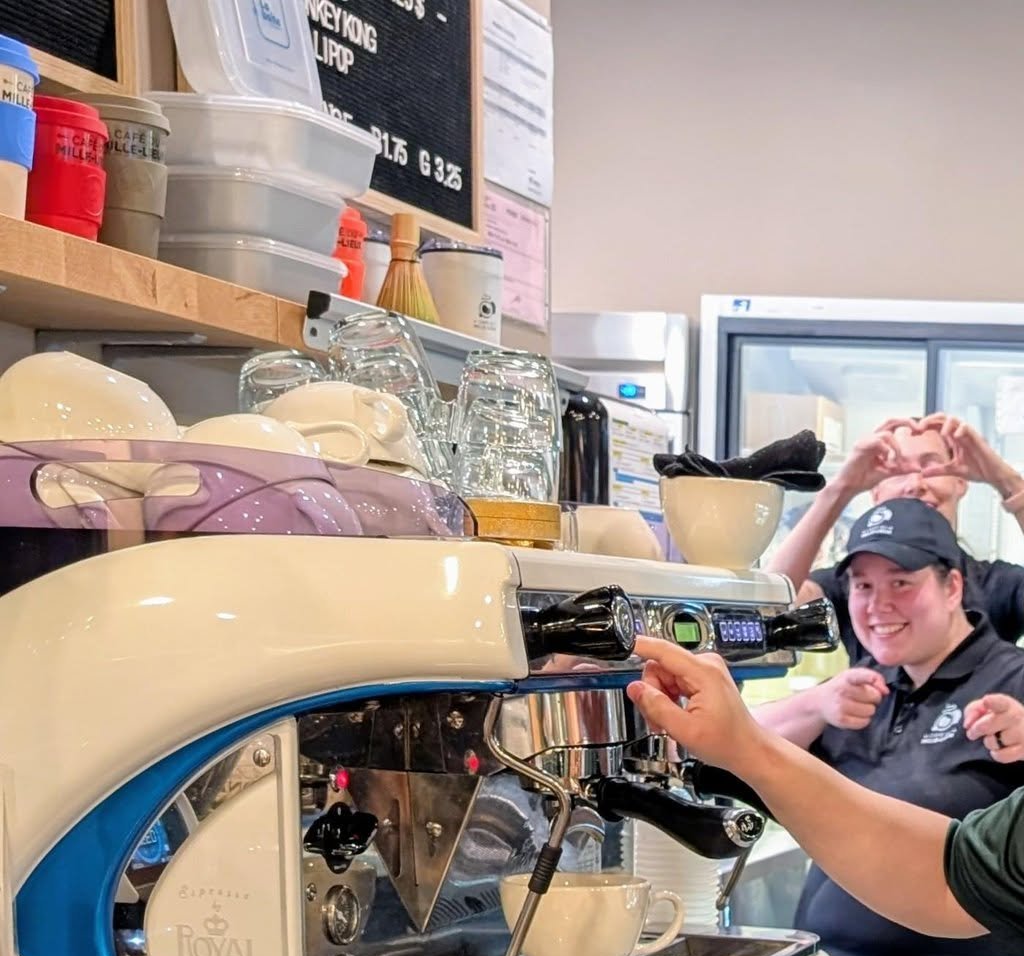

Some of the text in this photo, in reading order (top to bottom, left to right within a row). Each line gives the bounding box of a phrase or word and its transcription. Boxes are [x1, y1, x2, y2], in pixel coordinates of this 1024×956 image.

[307, 0, 341, 33] NKEY
[342, 10, 378, 53] KONG
[313, 30, 354, 74] LIPOP
